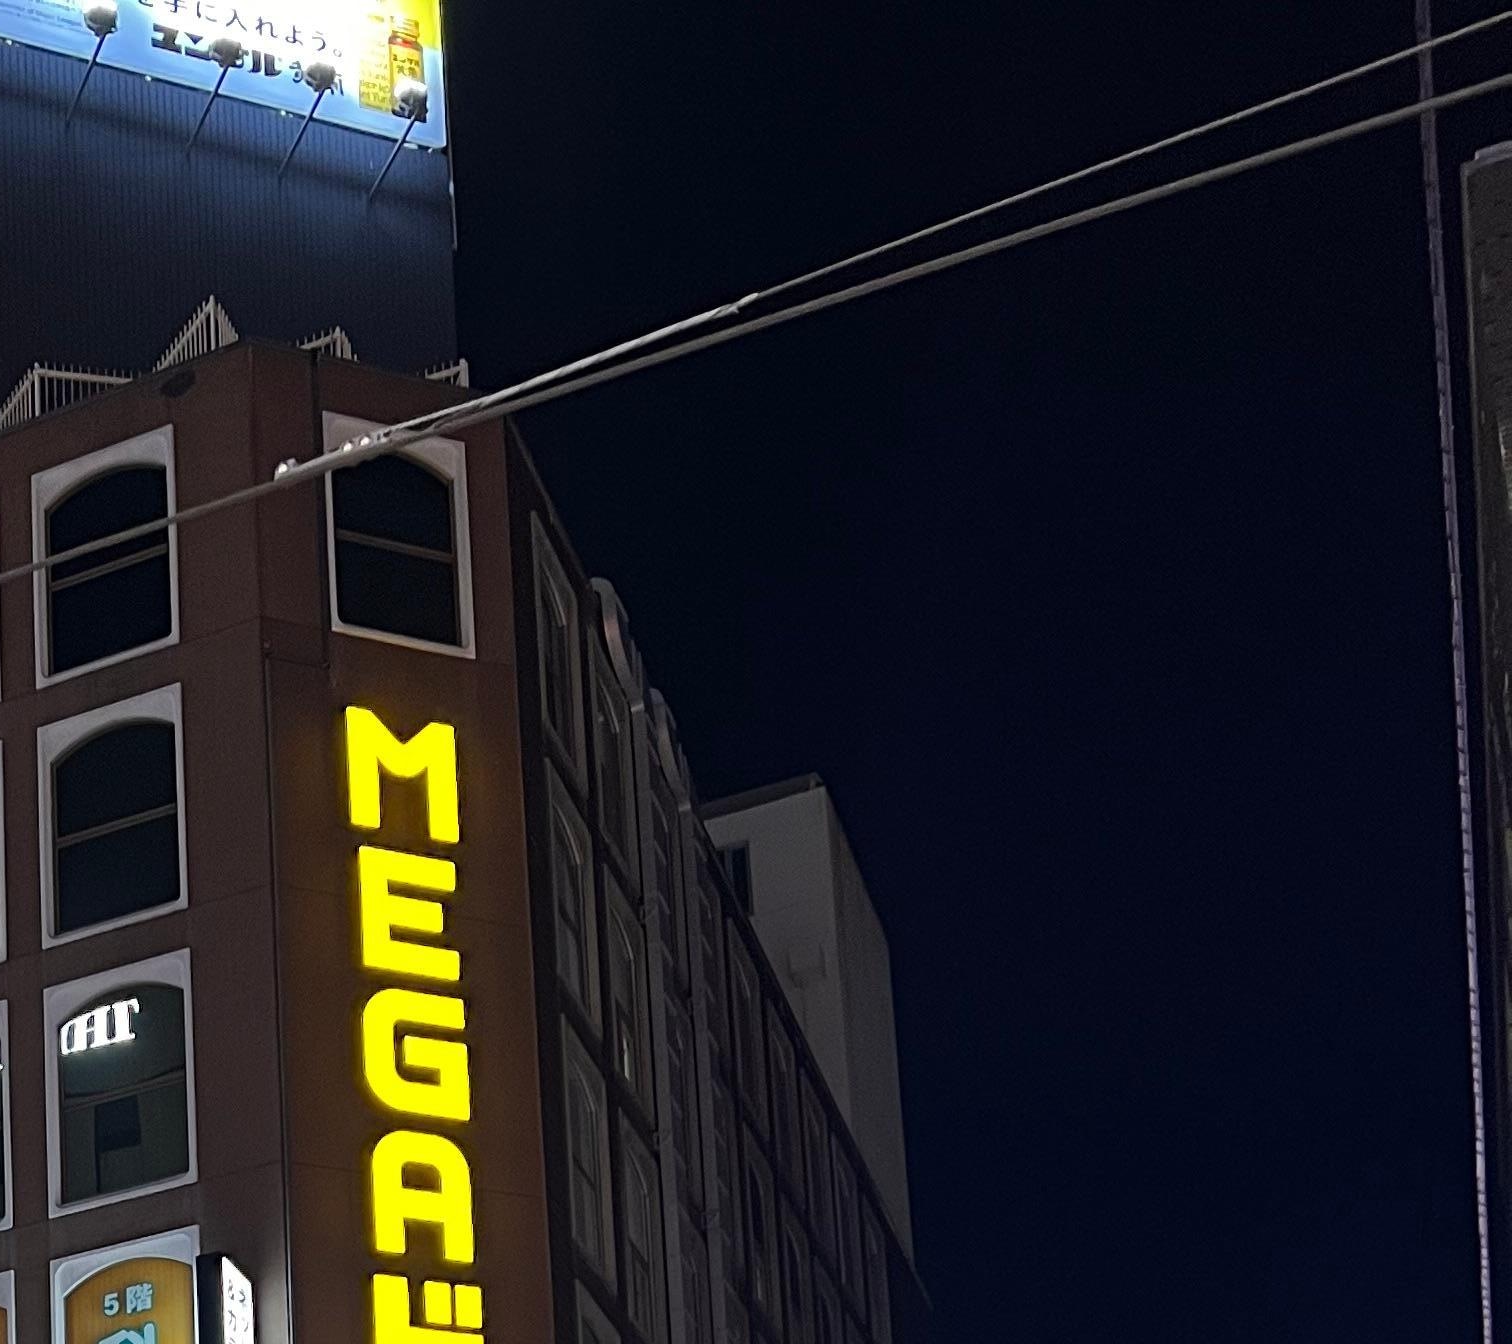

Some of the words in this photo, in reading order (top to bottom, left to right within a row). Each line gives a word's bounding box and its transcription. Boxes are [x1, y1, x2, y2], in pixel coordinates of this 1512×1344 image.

[150, 22, 283, 78] ユンル
[102, 1283, 155, 1317] 5階
